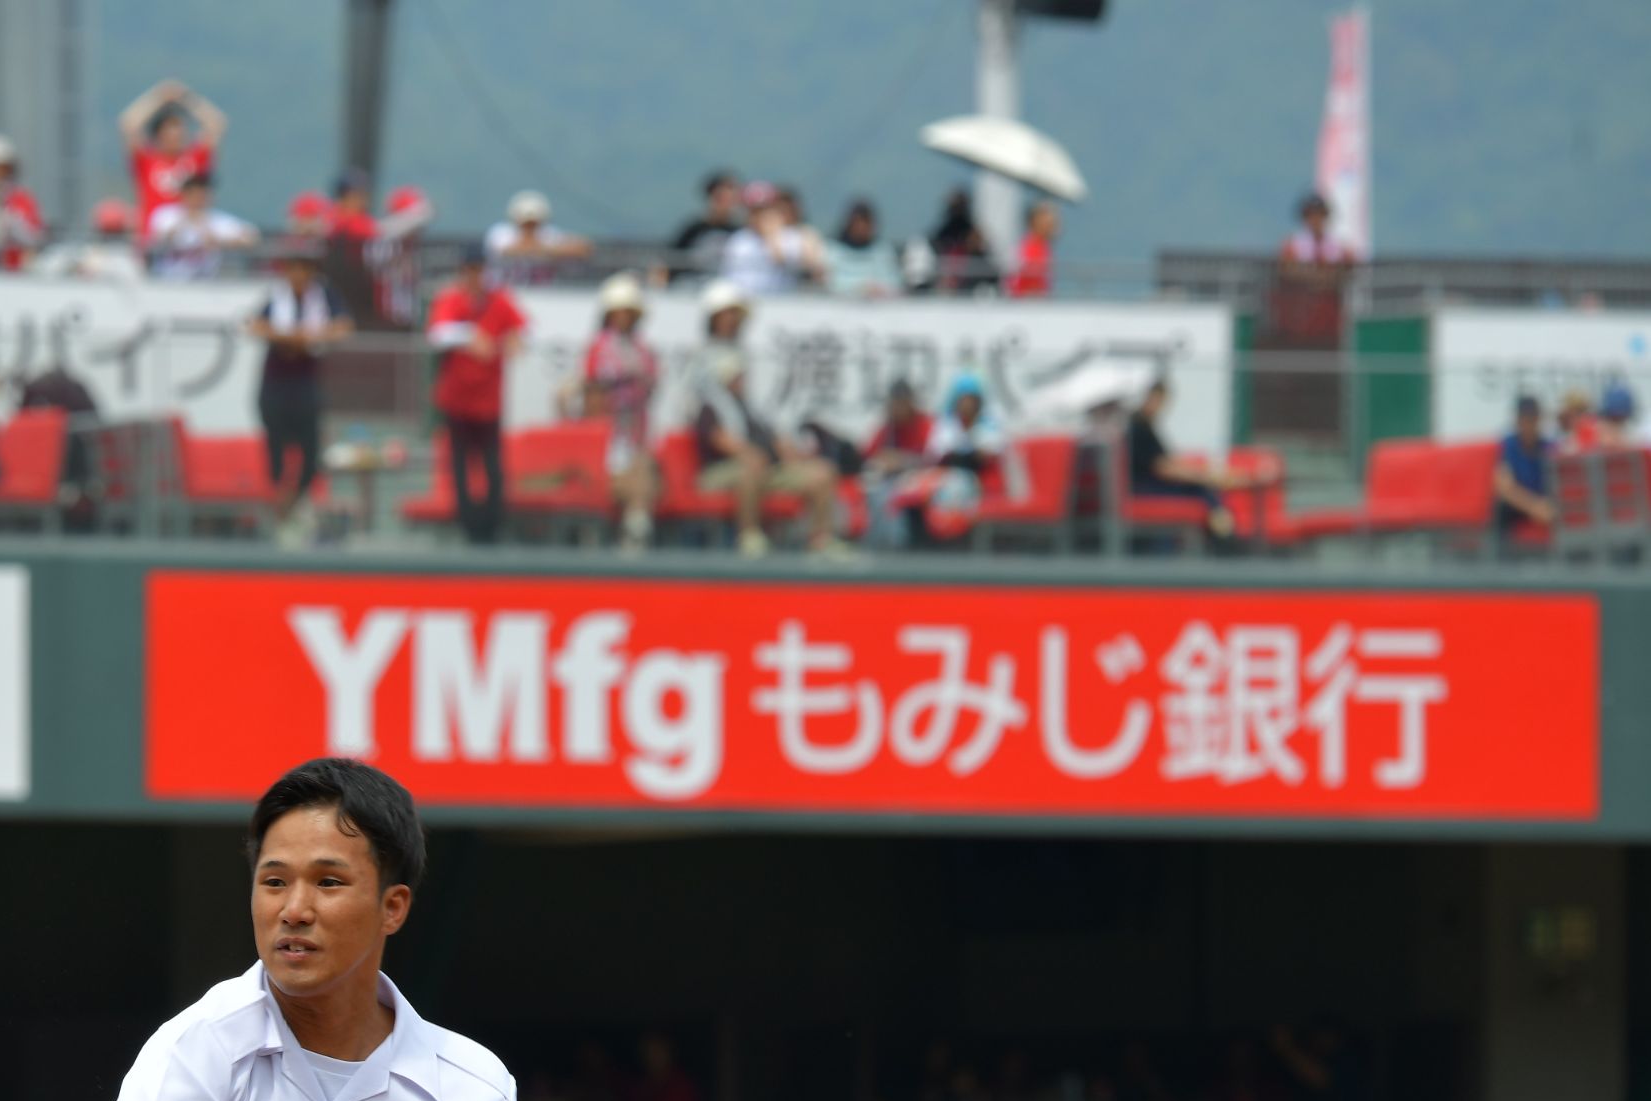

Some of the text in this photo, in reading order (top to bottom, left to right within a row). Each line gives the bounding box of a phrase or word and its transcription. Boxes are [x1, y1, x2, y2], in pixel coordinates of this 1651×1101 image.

[288, 605, 1447, 799] YMfg もみじ銀行
